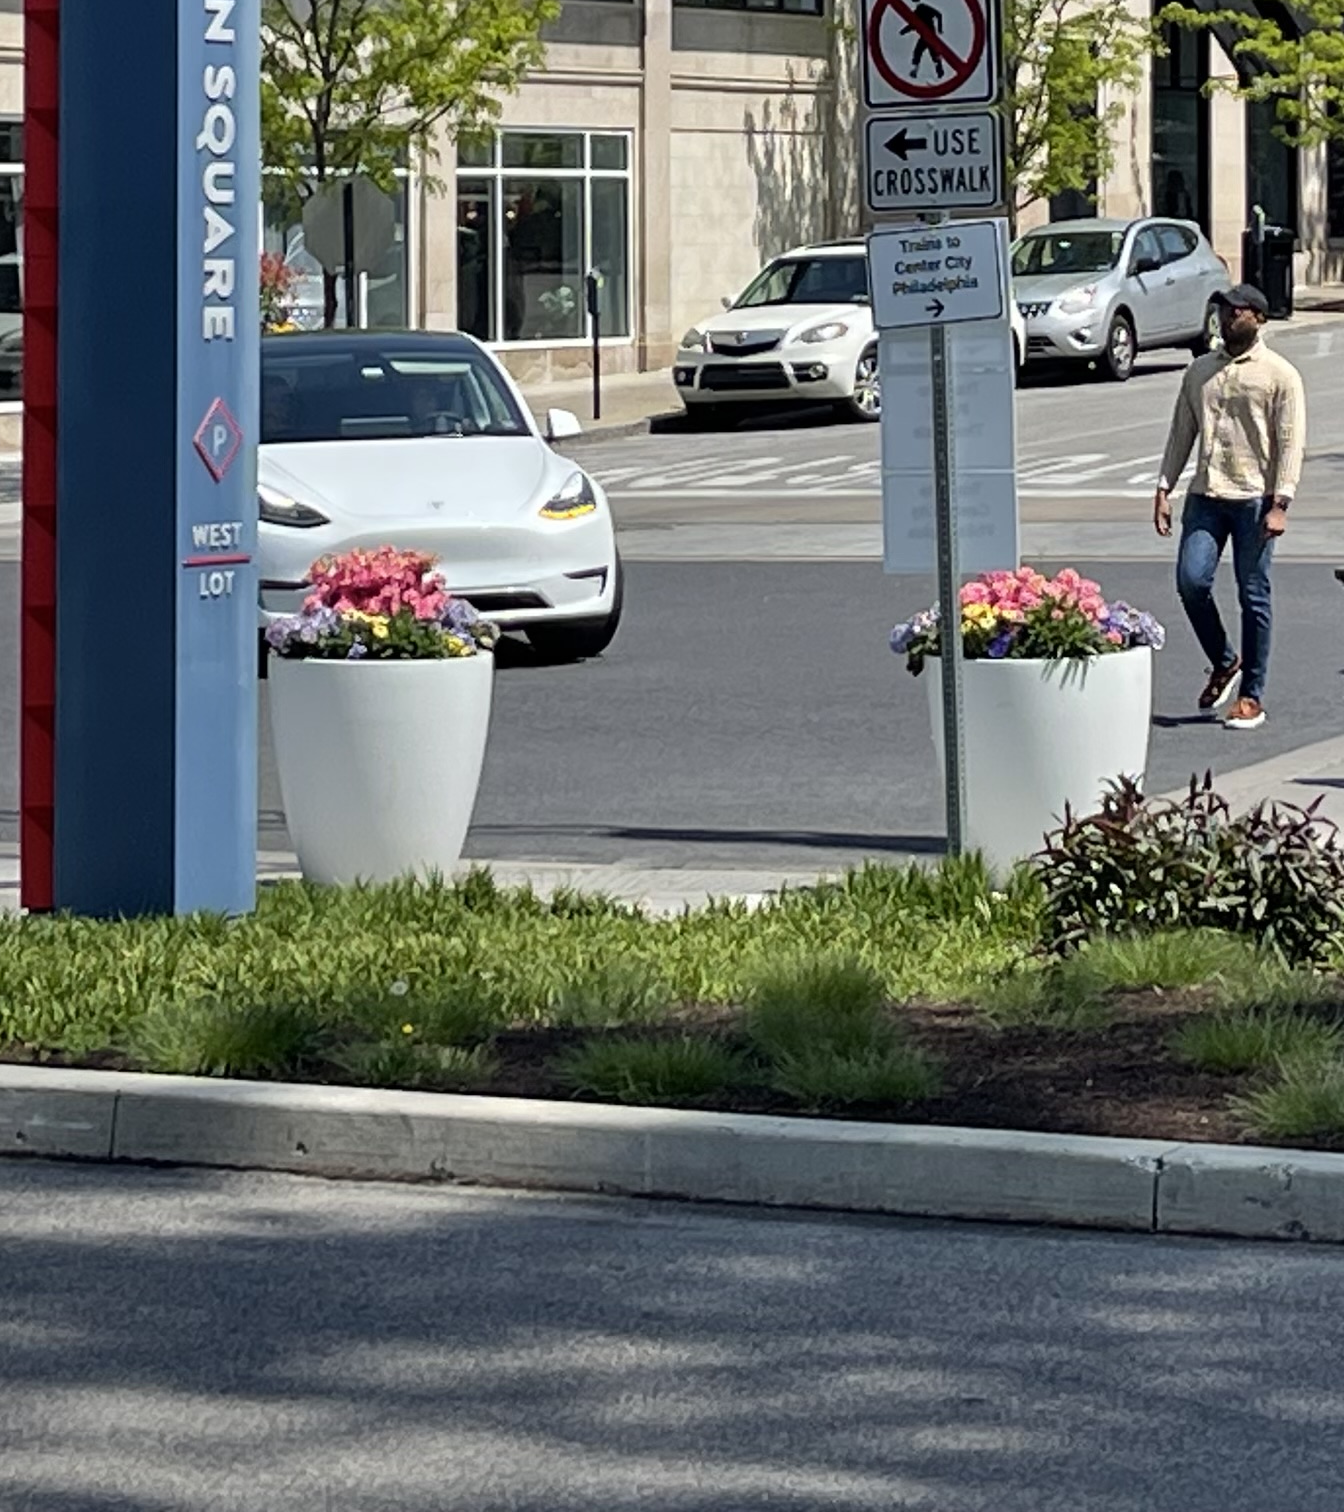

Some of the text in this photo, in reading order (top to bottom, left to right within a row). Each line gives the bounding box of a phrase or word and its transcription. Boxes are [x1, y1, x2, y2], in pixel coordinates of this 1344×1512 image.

[933, 126, 981, 156] USE
[873, 165, 991, 196] CROSSWALK
[196, 64, 236, 341] SQUARE
[899, 235, 961, 254] Trains to
[894, 255, 972, 275] Center City
[892, 275, 979, 297] Philadelphia
[212, 424, 227, 457] P
[192, 521, 243, 548] WEST
[199, 570, 235, 597] LOT
